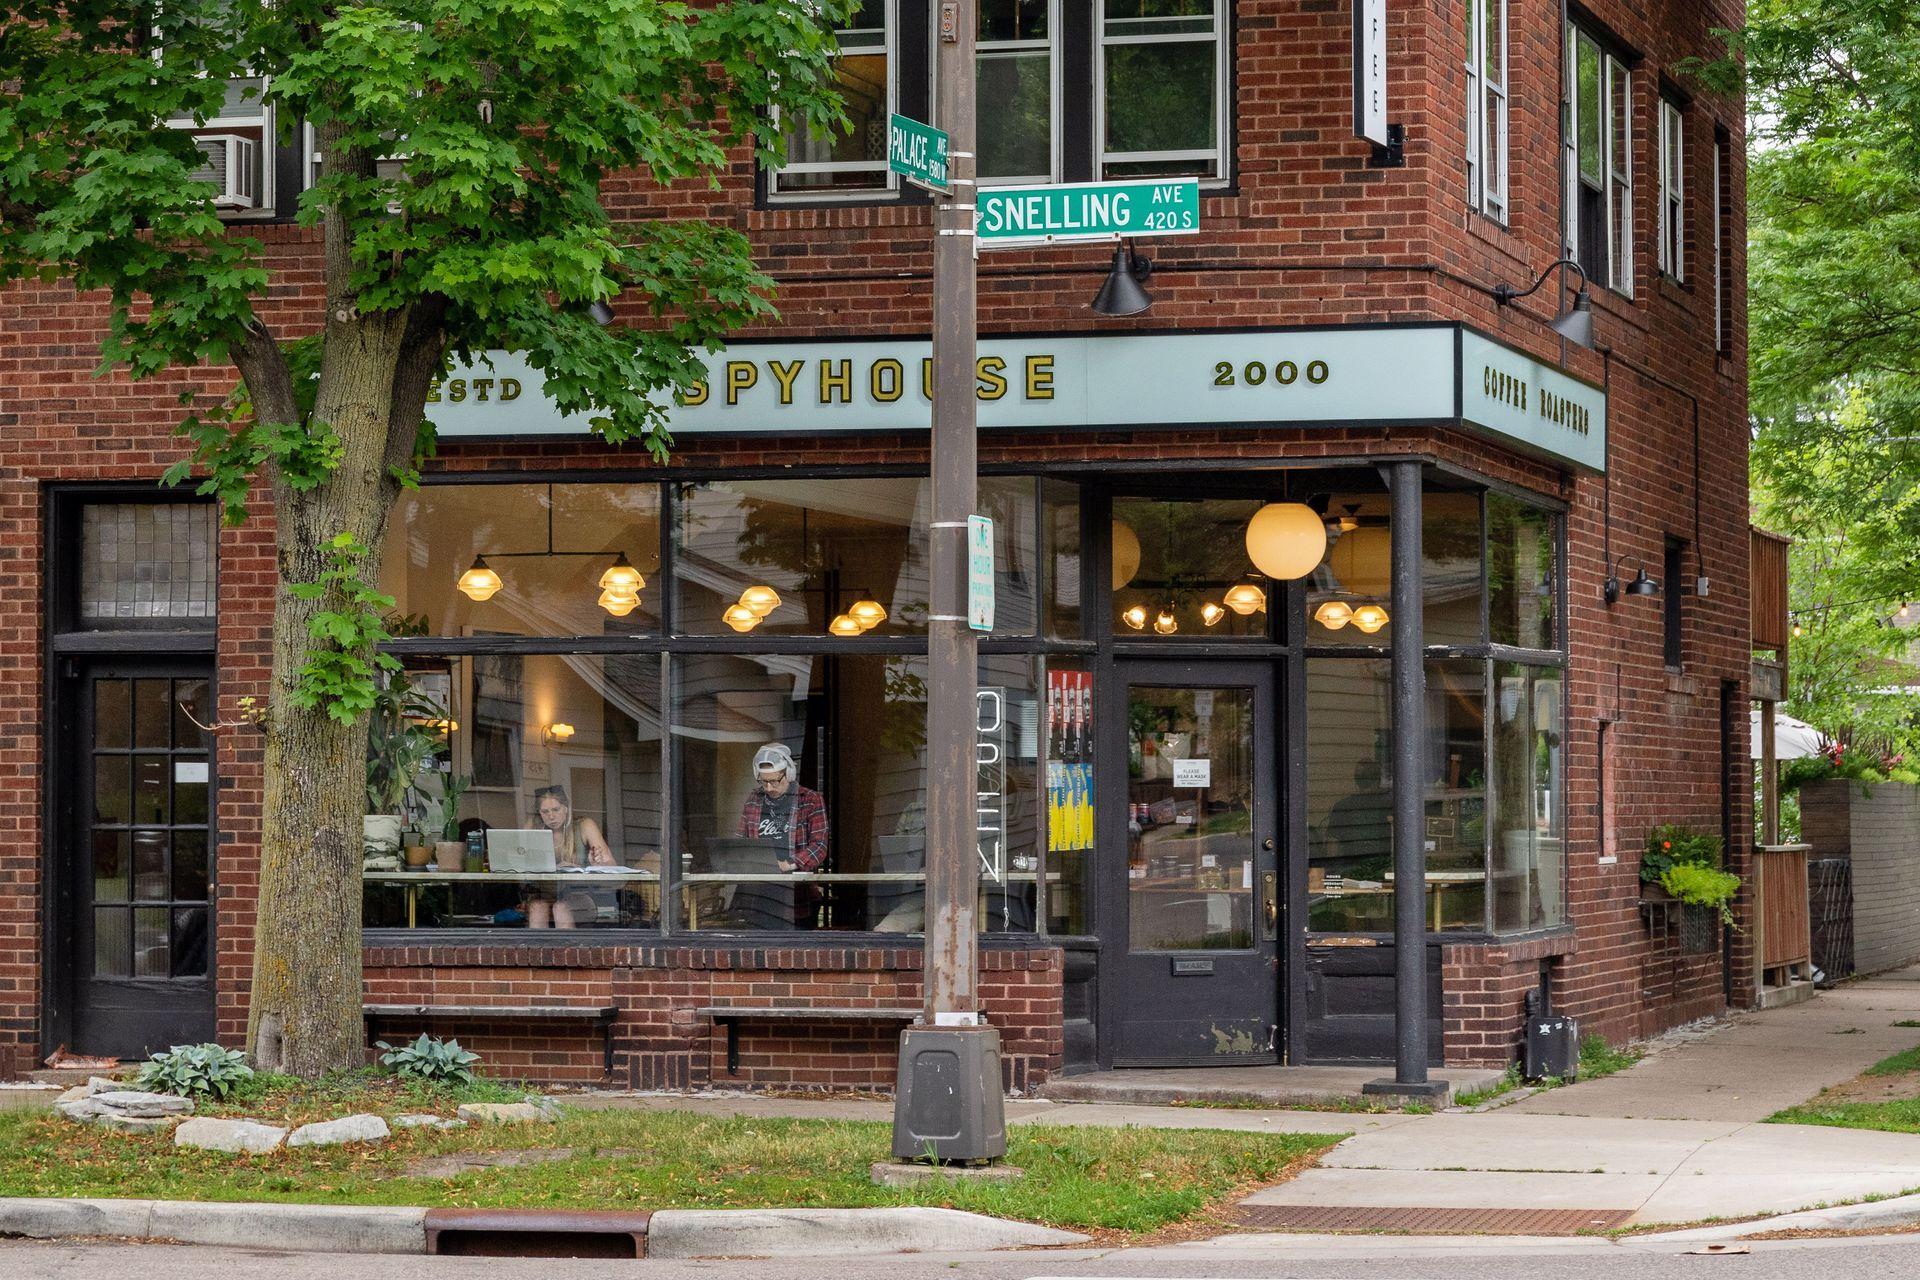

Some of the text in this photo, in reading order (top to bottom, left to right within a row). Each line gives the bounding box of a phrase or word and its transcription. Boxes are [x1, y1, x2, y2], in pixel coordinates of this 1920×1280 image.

[892, 126, 928, 171] PALACE
[937, 137, 947, 156] AVE
[985, 192, 1130, 232] SNELLING
[1152, 186, 1183, 204] AVE
[1144, 210, 1192, 230] 420 S
[426, 378, 522, 403] ESTD
[1214, 360, 1329, 386] 2000
[1484, 365, 1589, 436] COFFEE ROASTERS
